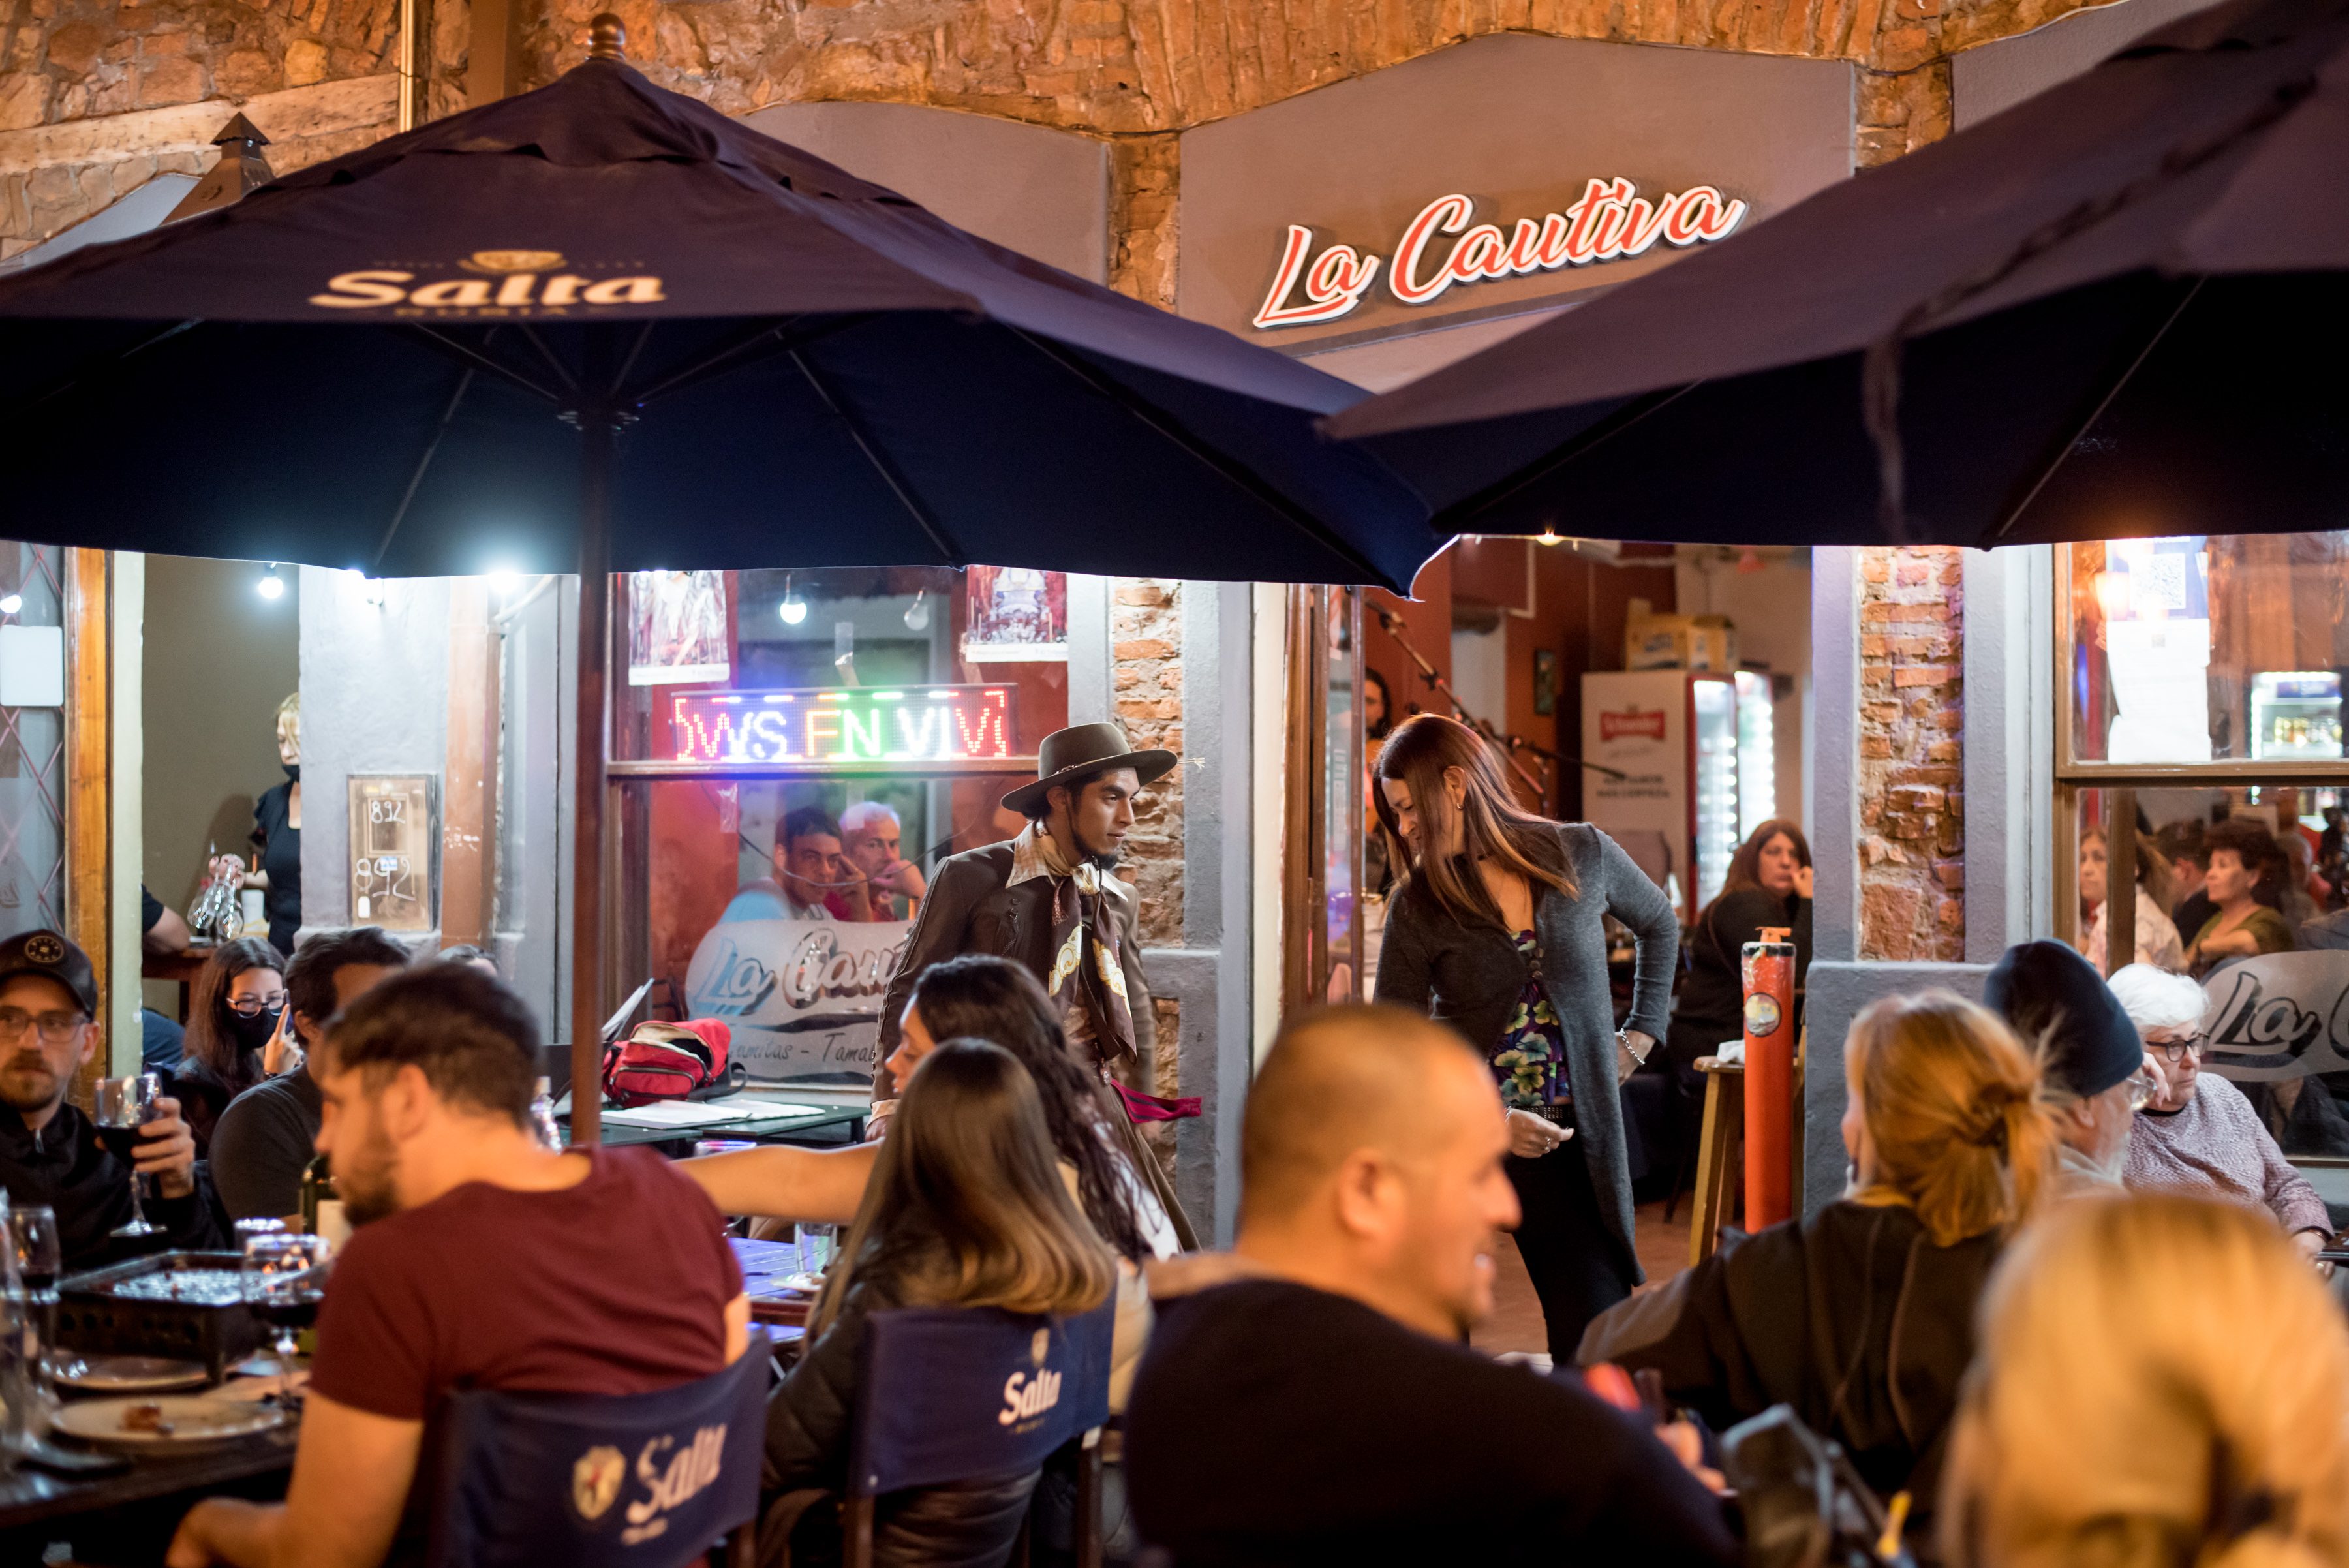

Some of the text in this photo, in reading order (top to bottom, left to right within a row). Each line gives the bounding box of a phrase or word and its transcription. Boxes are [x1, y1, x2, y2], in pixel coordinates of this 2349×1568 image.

[1252, 176, 1747, 330] La Cautiva
[308, 269, 666, 307] Salta
[371, 800, 406, 824] 892
